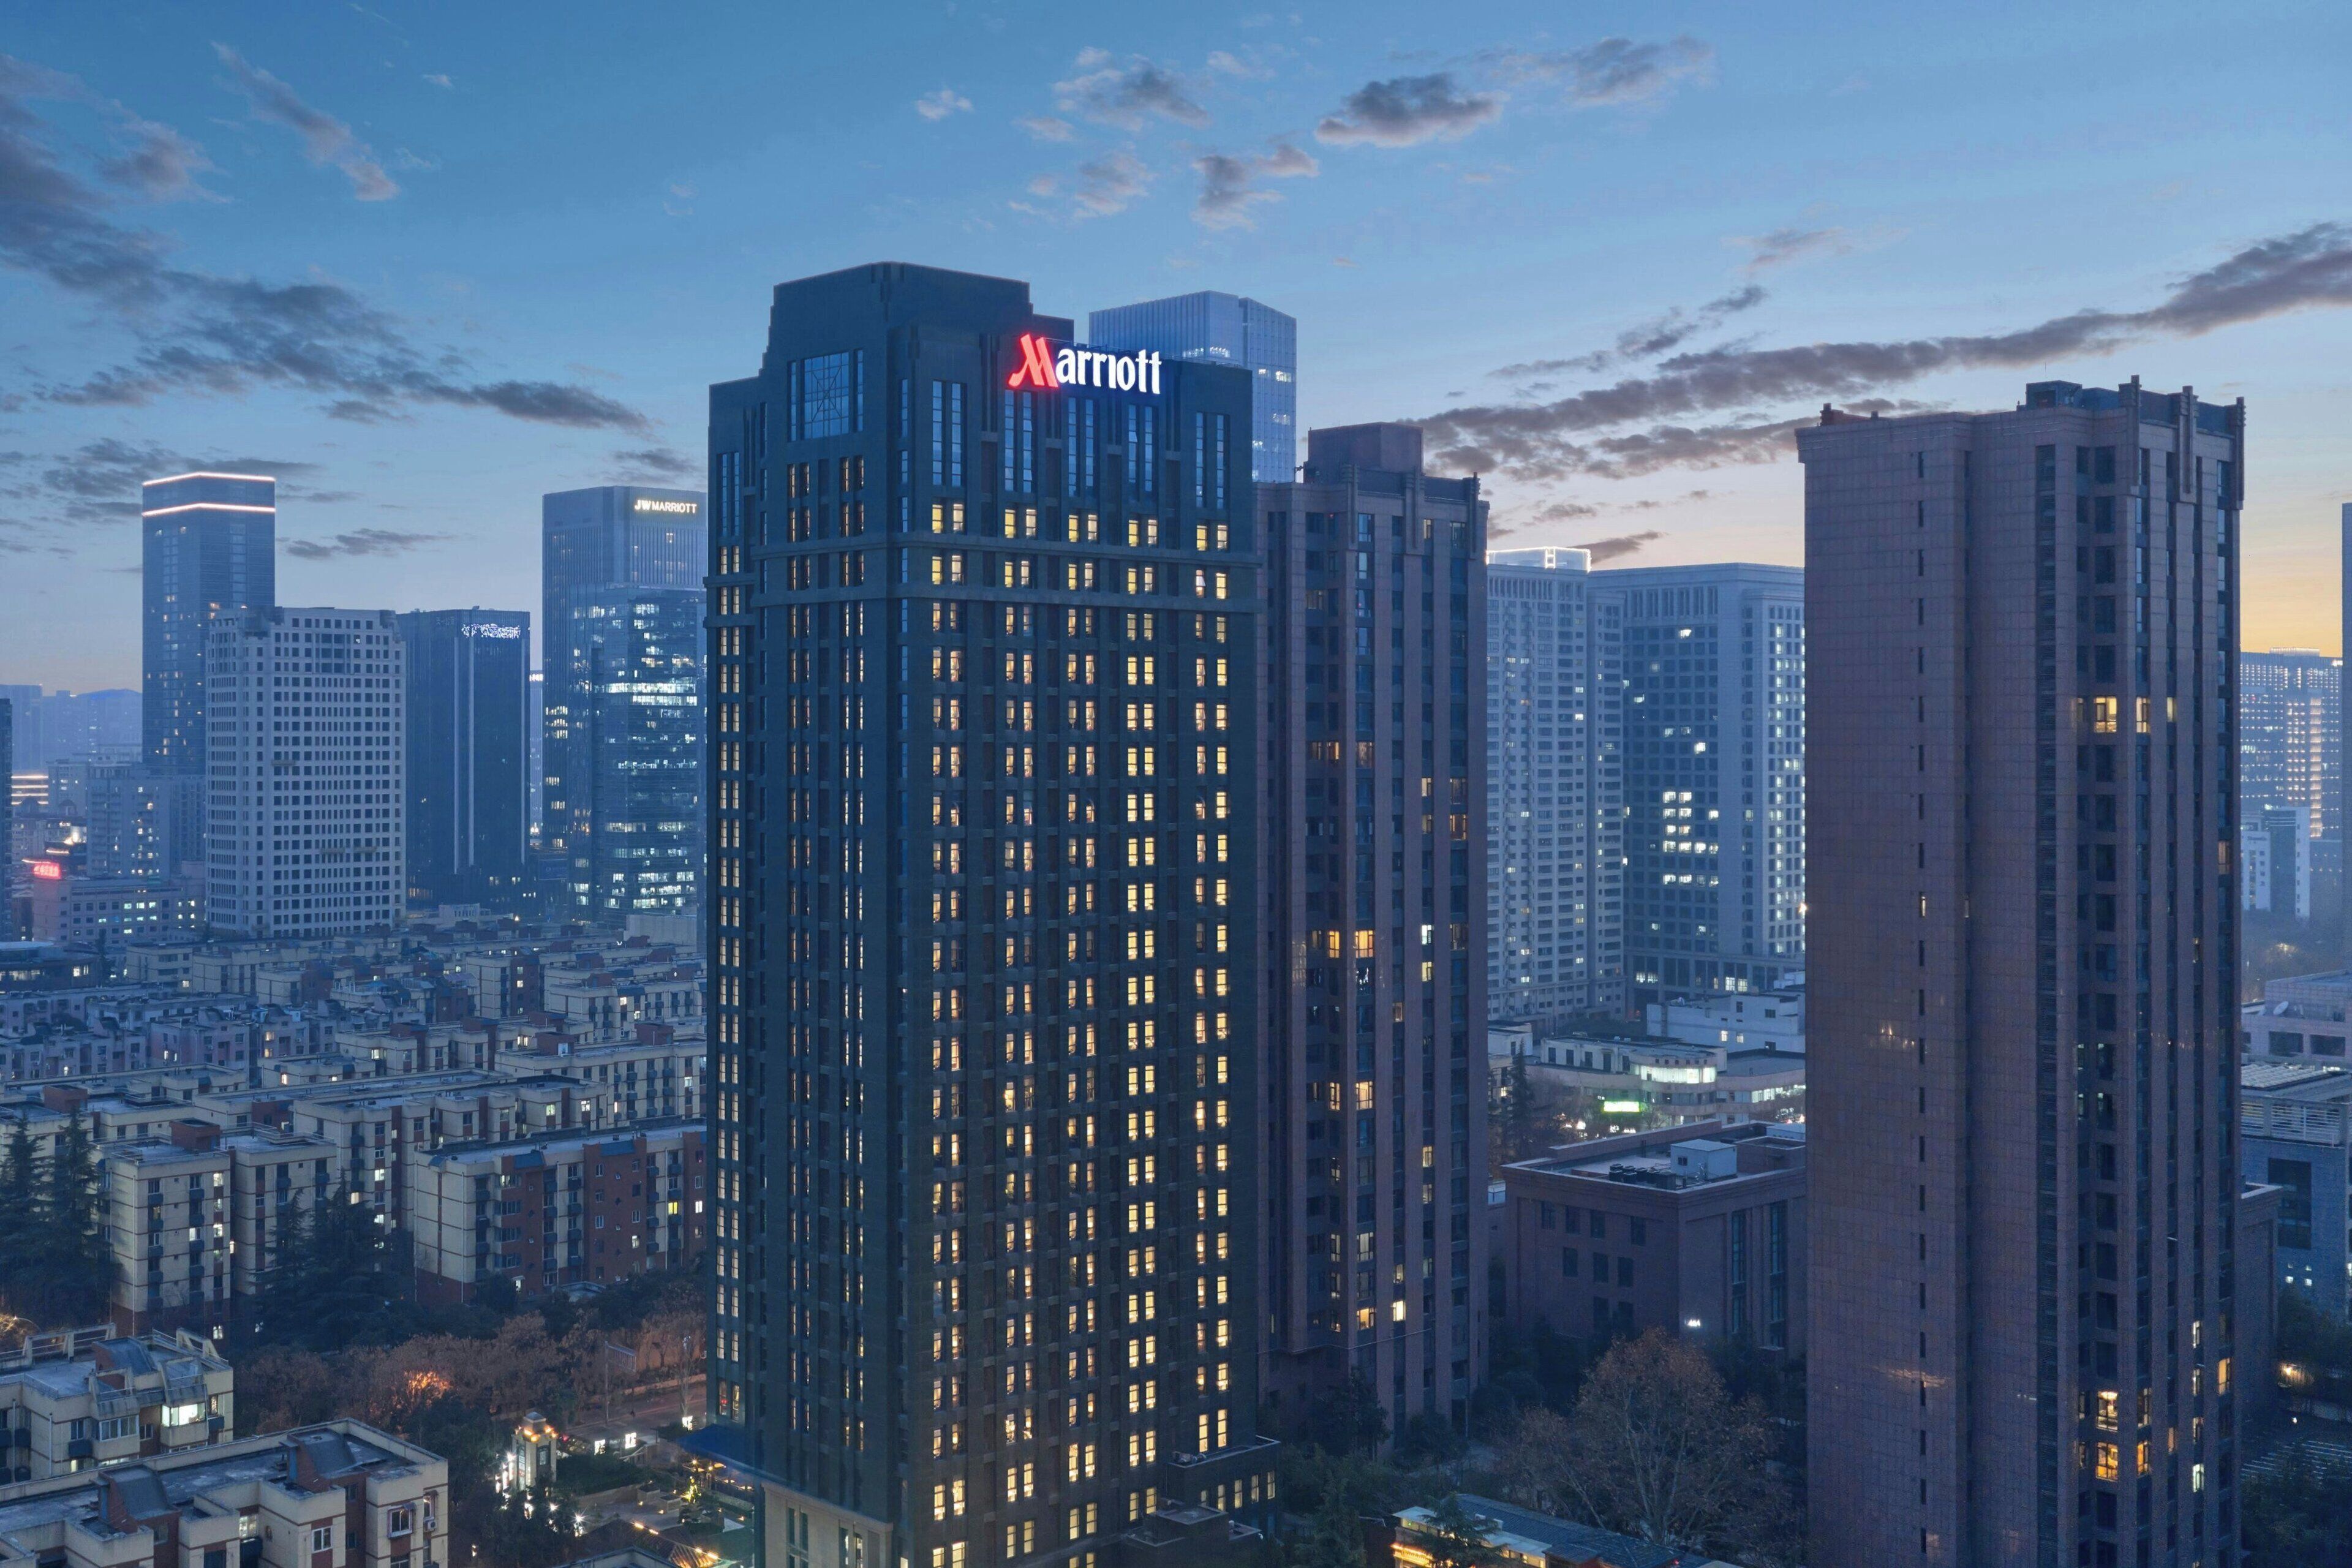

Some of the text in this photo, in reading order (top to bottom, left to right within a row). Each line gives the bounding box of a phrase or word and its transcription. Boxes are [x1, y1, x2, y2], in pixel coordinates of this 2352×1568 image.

[1008, 334, 1162, 394] Marriott
[635, 500, 697, 513] JW MARRIOTT
